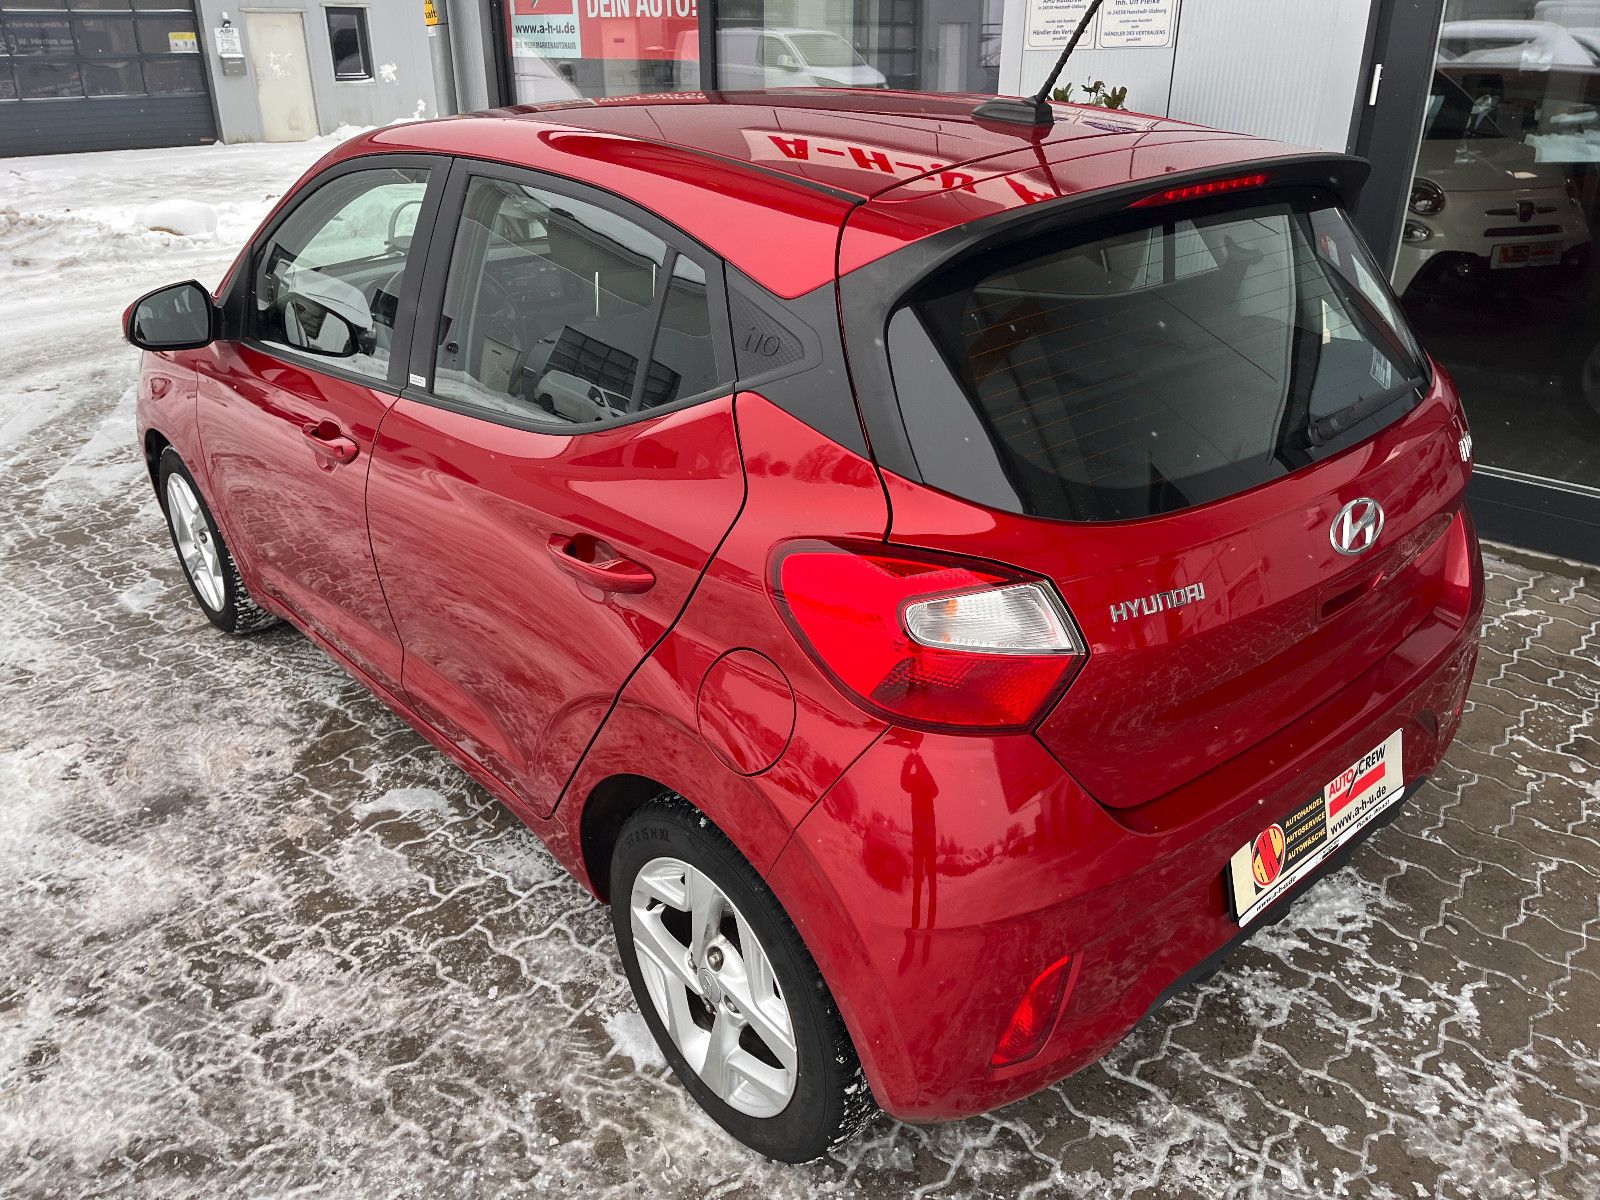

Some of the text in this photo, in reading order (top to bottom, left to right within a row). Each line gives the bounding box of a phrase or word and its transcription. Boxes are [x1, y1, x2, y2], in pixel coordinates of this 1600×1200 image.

[586, 0, 697, 18] DEIN AUTO!
[515, 22, 576, 34] www.a-h-u.de
[1109, 582, 1206, 623] HYUNDAI
[1285, 797, 1324, 828] AUTOHANDEL
[1330, 786, 1387, 835] www.a-h-u.de
[1286, 811, 1326, 844] AUTOSERVICE
[1288, 827, 1326, 861] AUTOWÄSCHE
